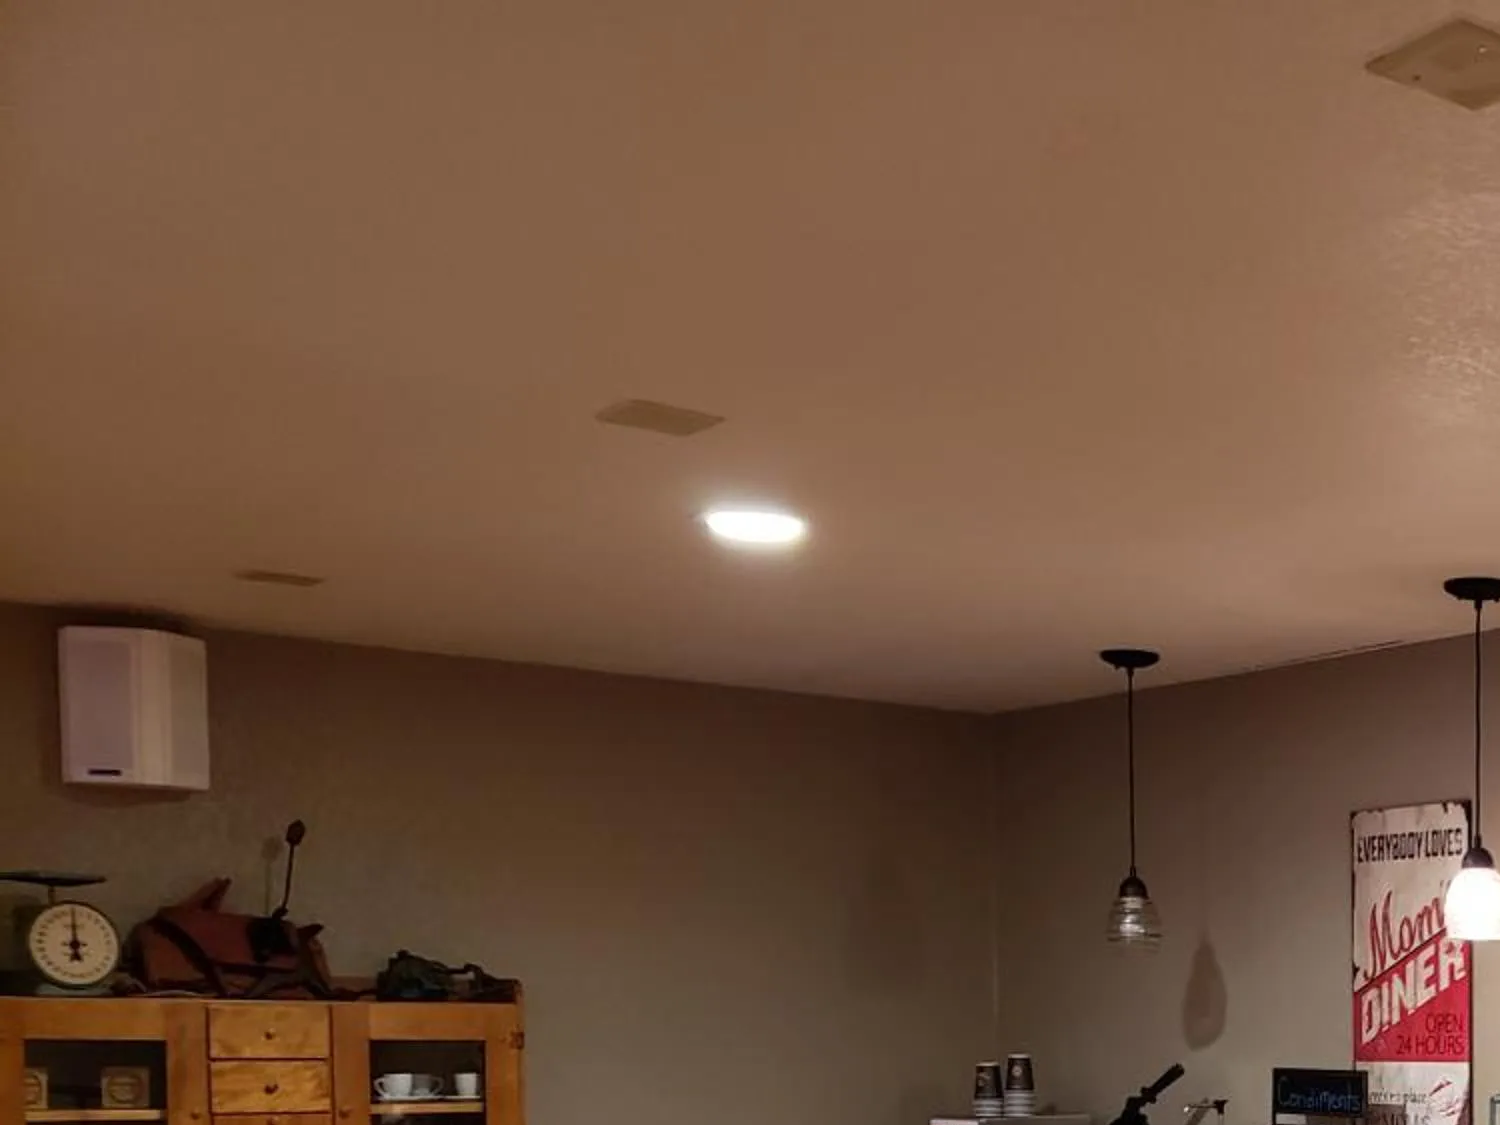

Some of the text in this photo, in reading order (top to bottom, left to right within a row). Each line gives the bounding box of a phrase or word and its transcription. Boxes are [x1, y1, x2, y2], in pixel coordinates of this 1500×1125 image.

[1357, 828, 1463, 863] EVERYBODY LOVES
[1363, 879, 1452, 981] Mom'
[1360, 938, 1467, 1045] DINER
[1425, 1011, 1464, 1034] OPEN
[1396, 1032, 1465, 1056] 24 HOURS
